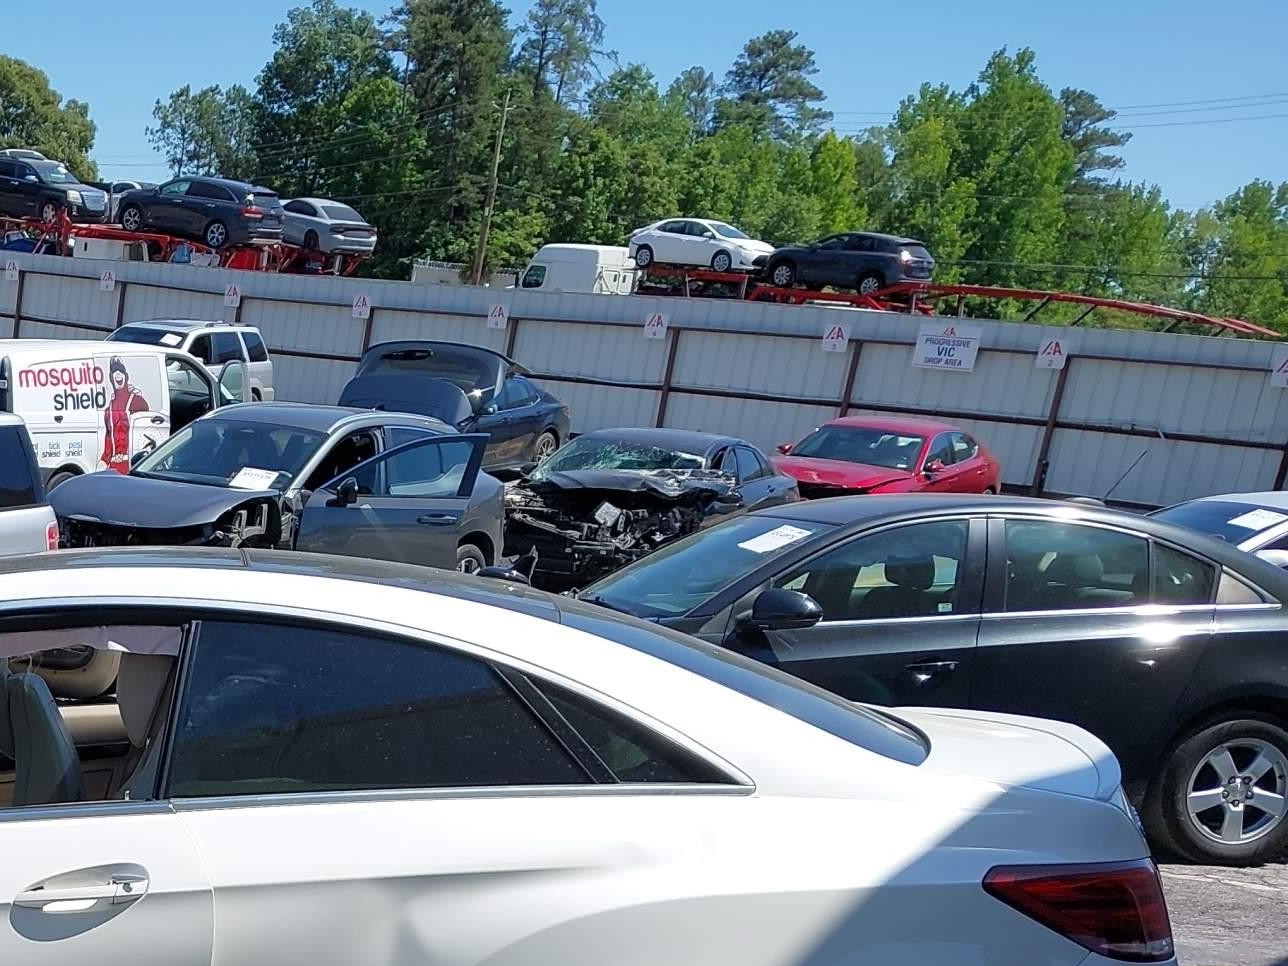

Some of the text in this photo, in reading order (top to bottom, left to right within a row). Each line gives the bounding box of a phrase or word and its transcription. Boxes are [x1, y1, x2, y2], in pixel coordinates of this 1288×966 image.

[924, 337, 971, 347] PROGRESSIVE
[937, 346, 956, 357] VIC
[18, 362, 104, 392] mosquito
[53, 386, 107, 411] shield
[48, 441, 61, 450] tick
